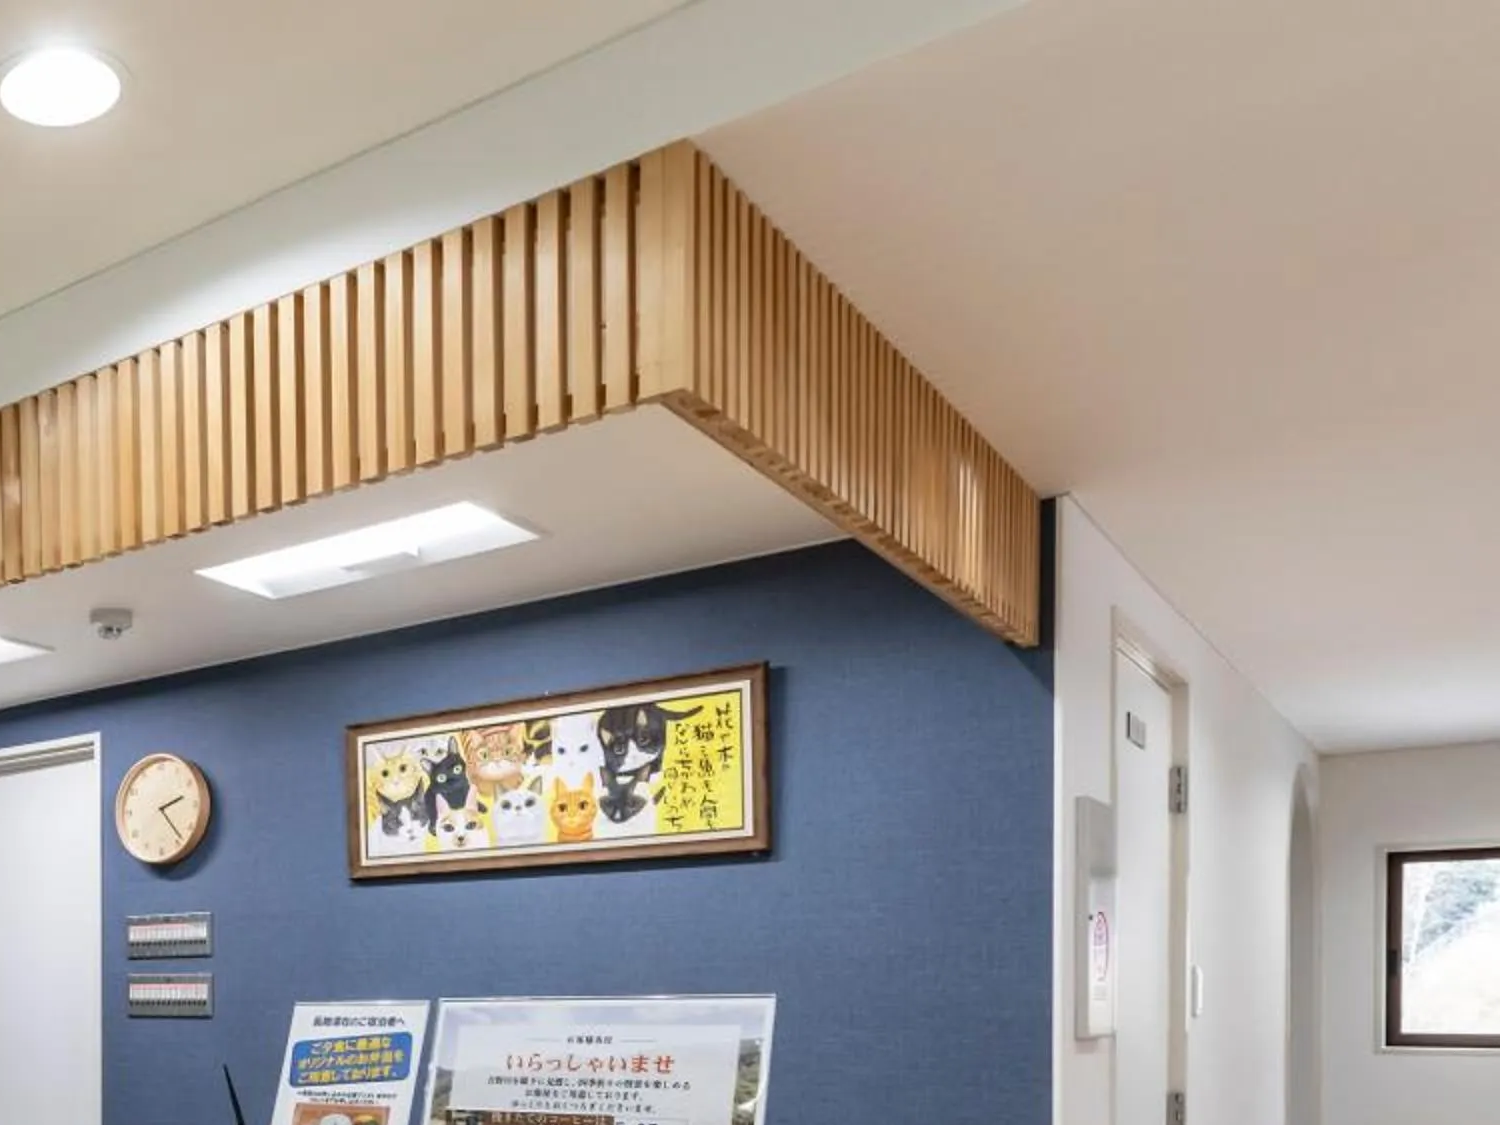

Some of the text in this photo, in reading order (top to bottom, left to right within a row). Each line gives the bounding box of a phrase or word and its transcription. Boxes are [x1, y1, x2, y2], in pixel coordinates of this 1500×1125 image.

[506, 1053, 675, 1074] いらっしゃいませ
